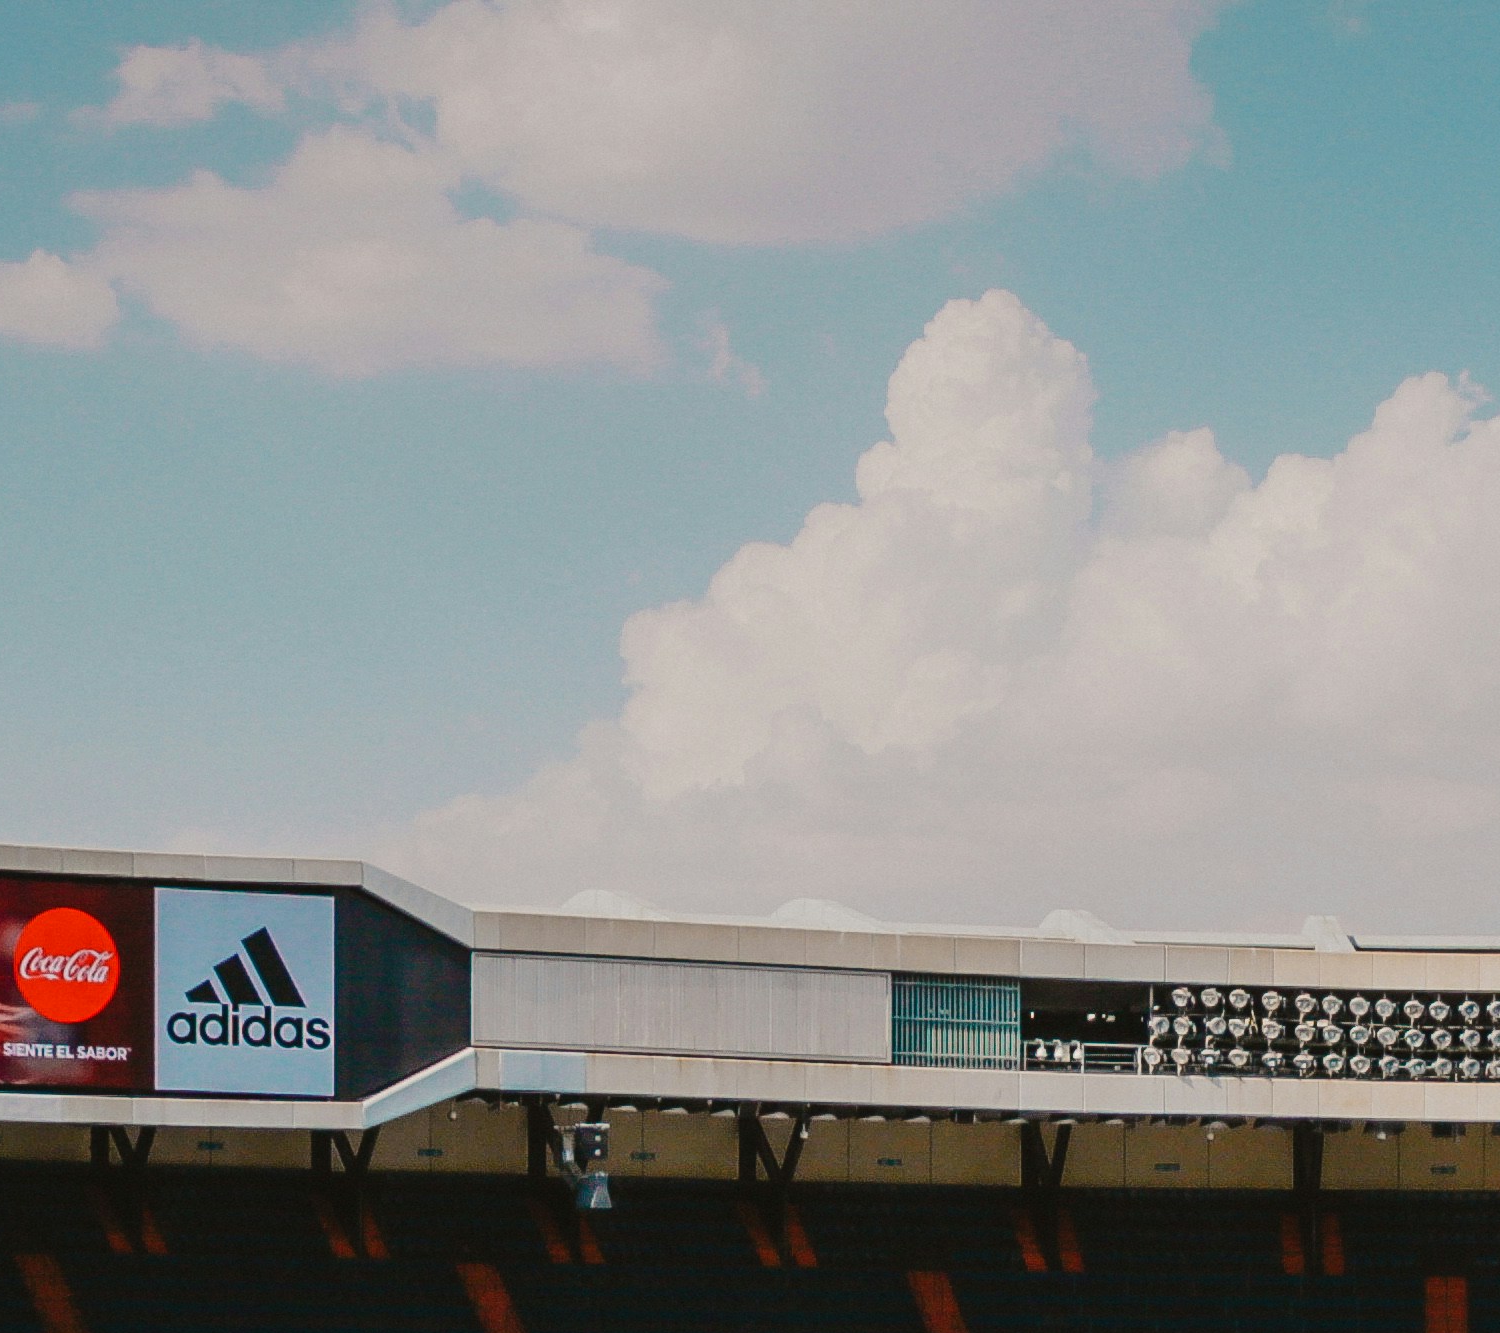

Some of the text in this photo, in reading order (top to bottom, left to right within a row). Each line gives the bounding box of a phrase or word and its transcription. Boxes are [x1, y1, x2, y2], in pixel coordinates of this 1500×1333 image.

[167, 1003, 331, 1050] adidas
[3, 1042, 53, 1059] SIENTE
[56, 1044, 74, 1059] EL
